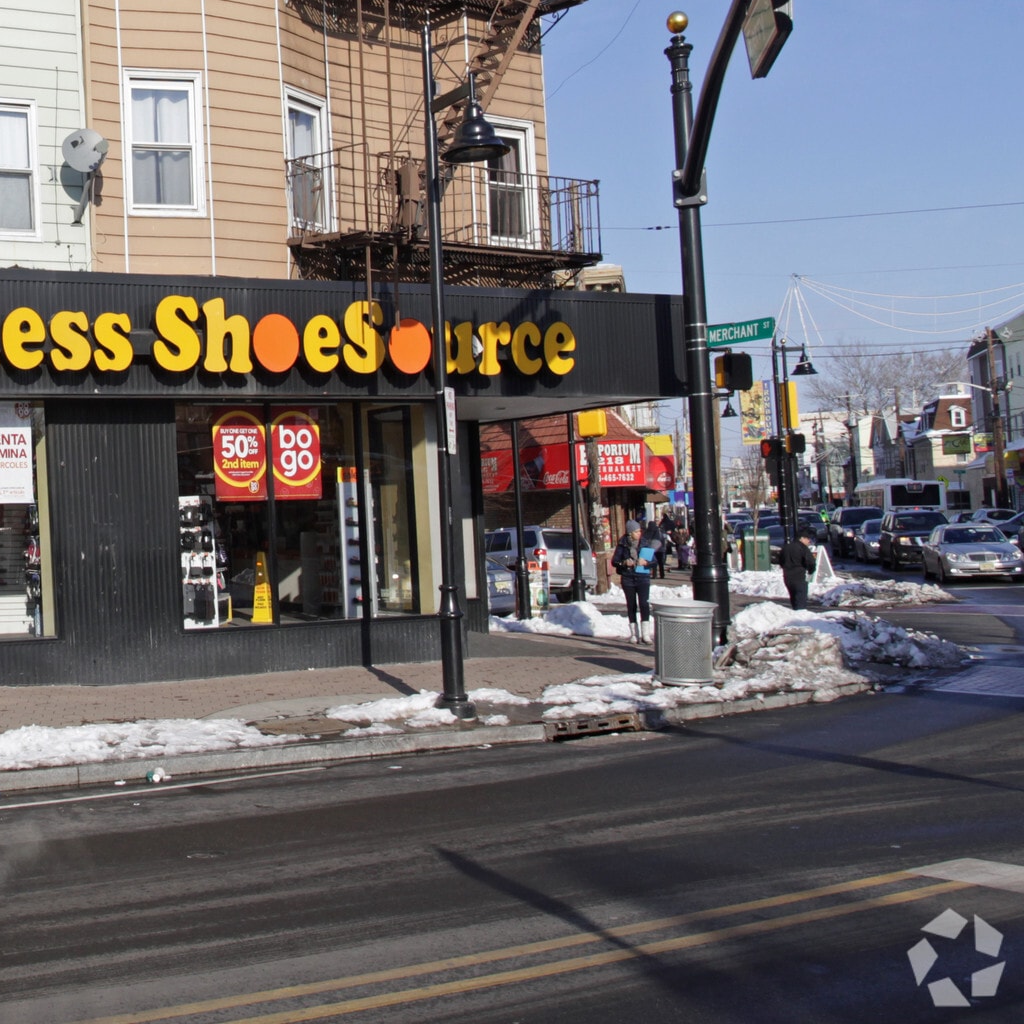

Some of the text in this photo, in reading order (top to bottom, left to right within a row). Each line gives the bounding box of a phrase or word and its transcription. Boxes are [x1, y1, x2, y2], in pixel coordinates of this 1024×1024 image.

[153, 294, 576, 376] ShoeSource
[709, 321, 770, 343] MERCHANT ST
[221, 435, 259, 458] 50%
[279, 425, 313, 449] bo
[222, 458, 259, 468] 2nd item
[280, 450, 314, 477] go
[579, 443, 641, 466] EPORIUM
[580, 465, 642, 475] SERMARKET
